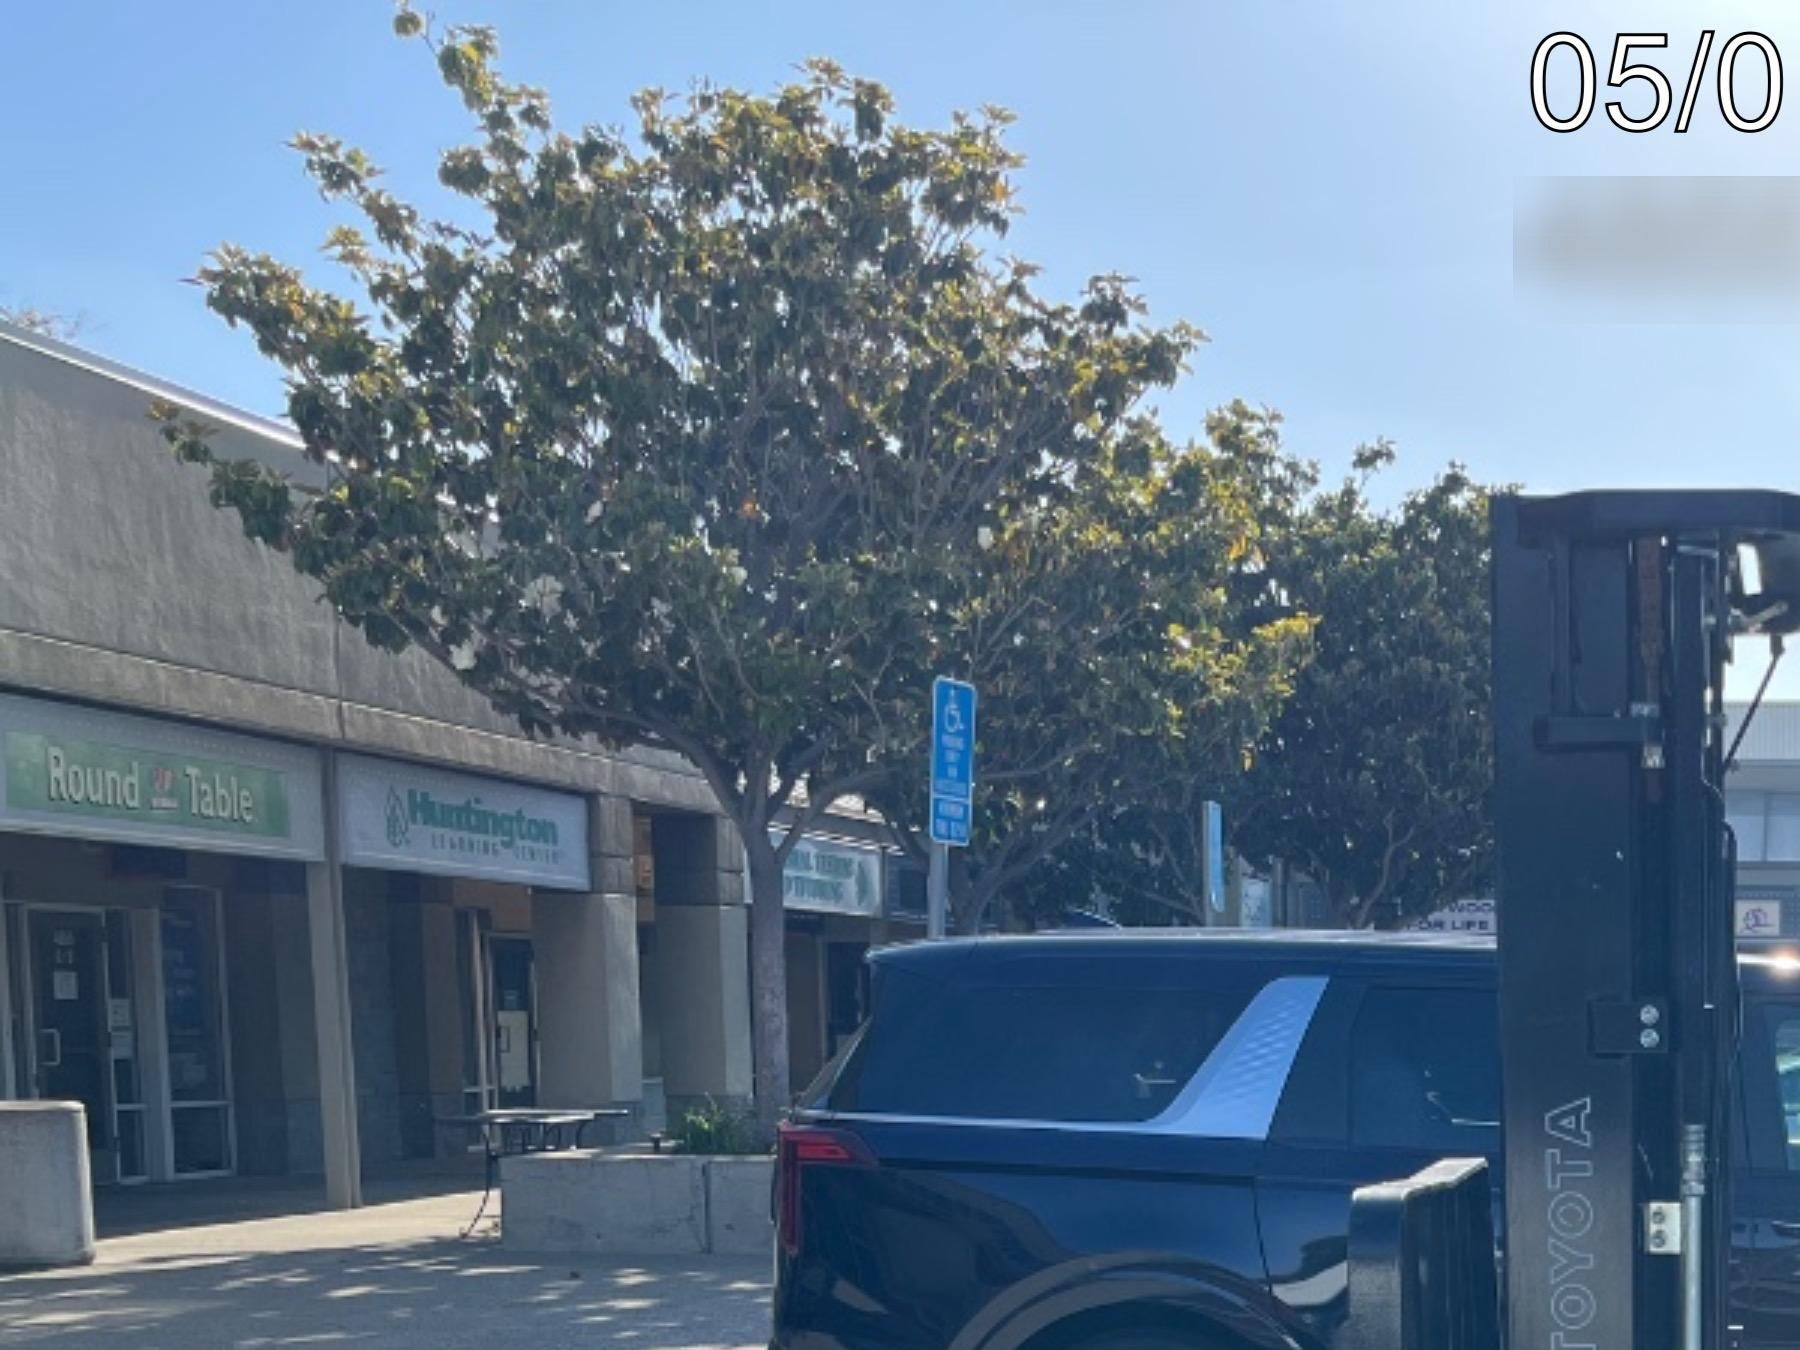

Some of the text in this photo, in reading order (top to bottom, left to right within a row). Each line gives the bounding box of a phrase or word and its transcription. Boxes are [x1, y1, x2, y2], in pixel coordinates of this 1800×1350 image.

[48, 746, 254, 822] Round Table
[407, 788, 559, 849] Huntington
